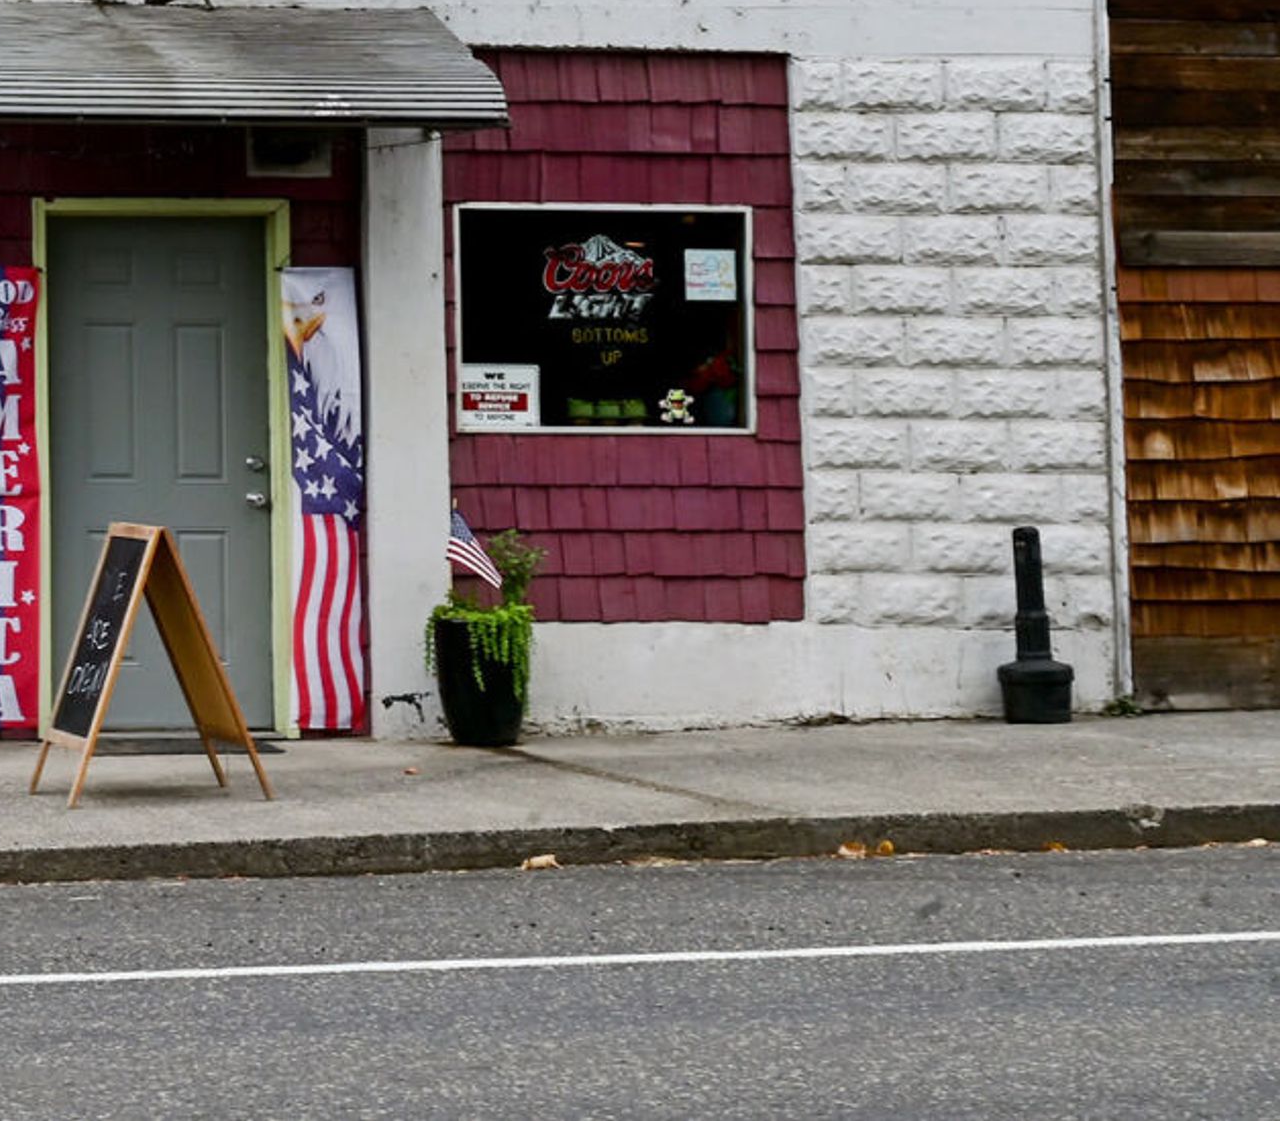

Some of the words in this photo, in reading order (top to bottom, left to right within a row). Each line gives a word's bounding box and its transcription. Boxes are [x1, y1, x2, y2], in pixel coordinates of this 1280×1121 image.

[543, 243, 654, 293] Coors
[571, 327, 649, 343] BOTTOMS
[600, 350, 622, 365] UP
[484, 372, 505, 380] WE
